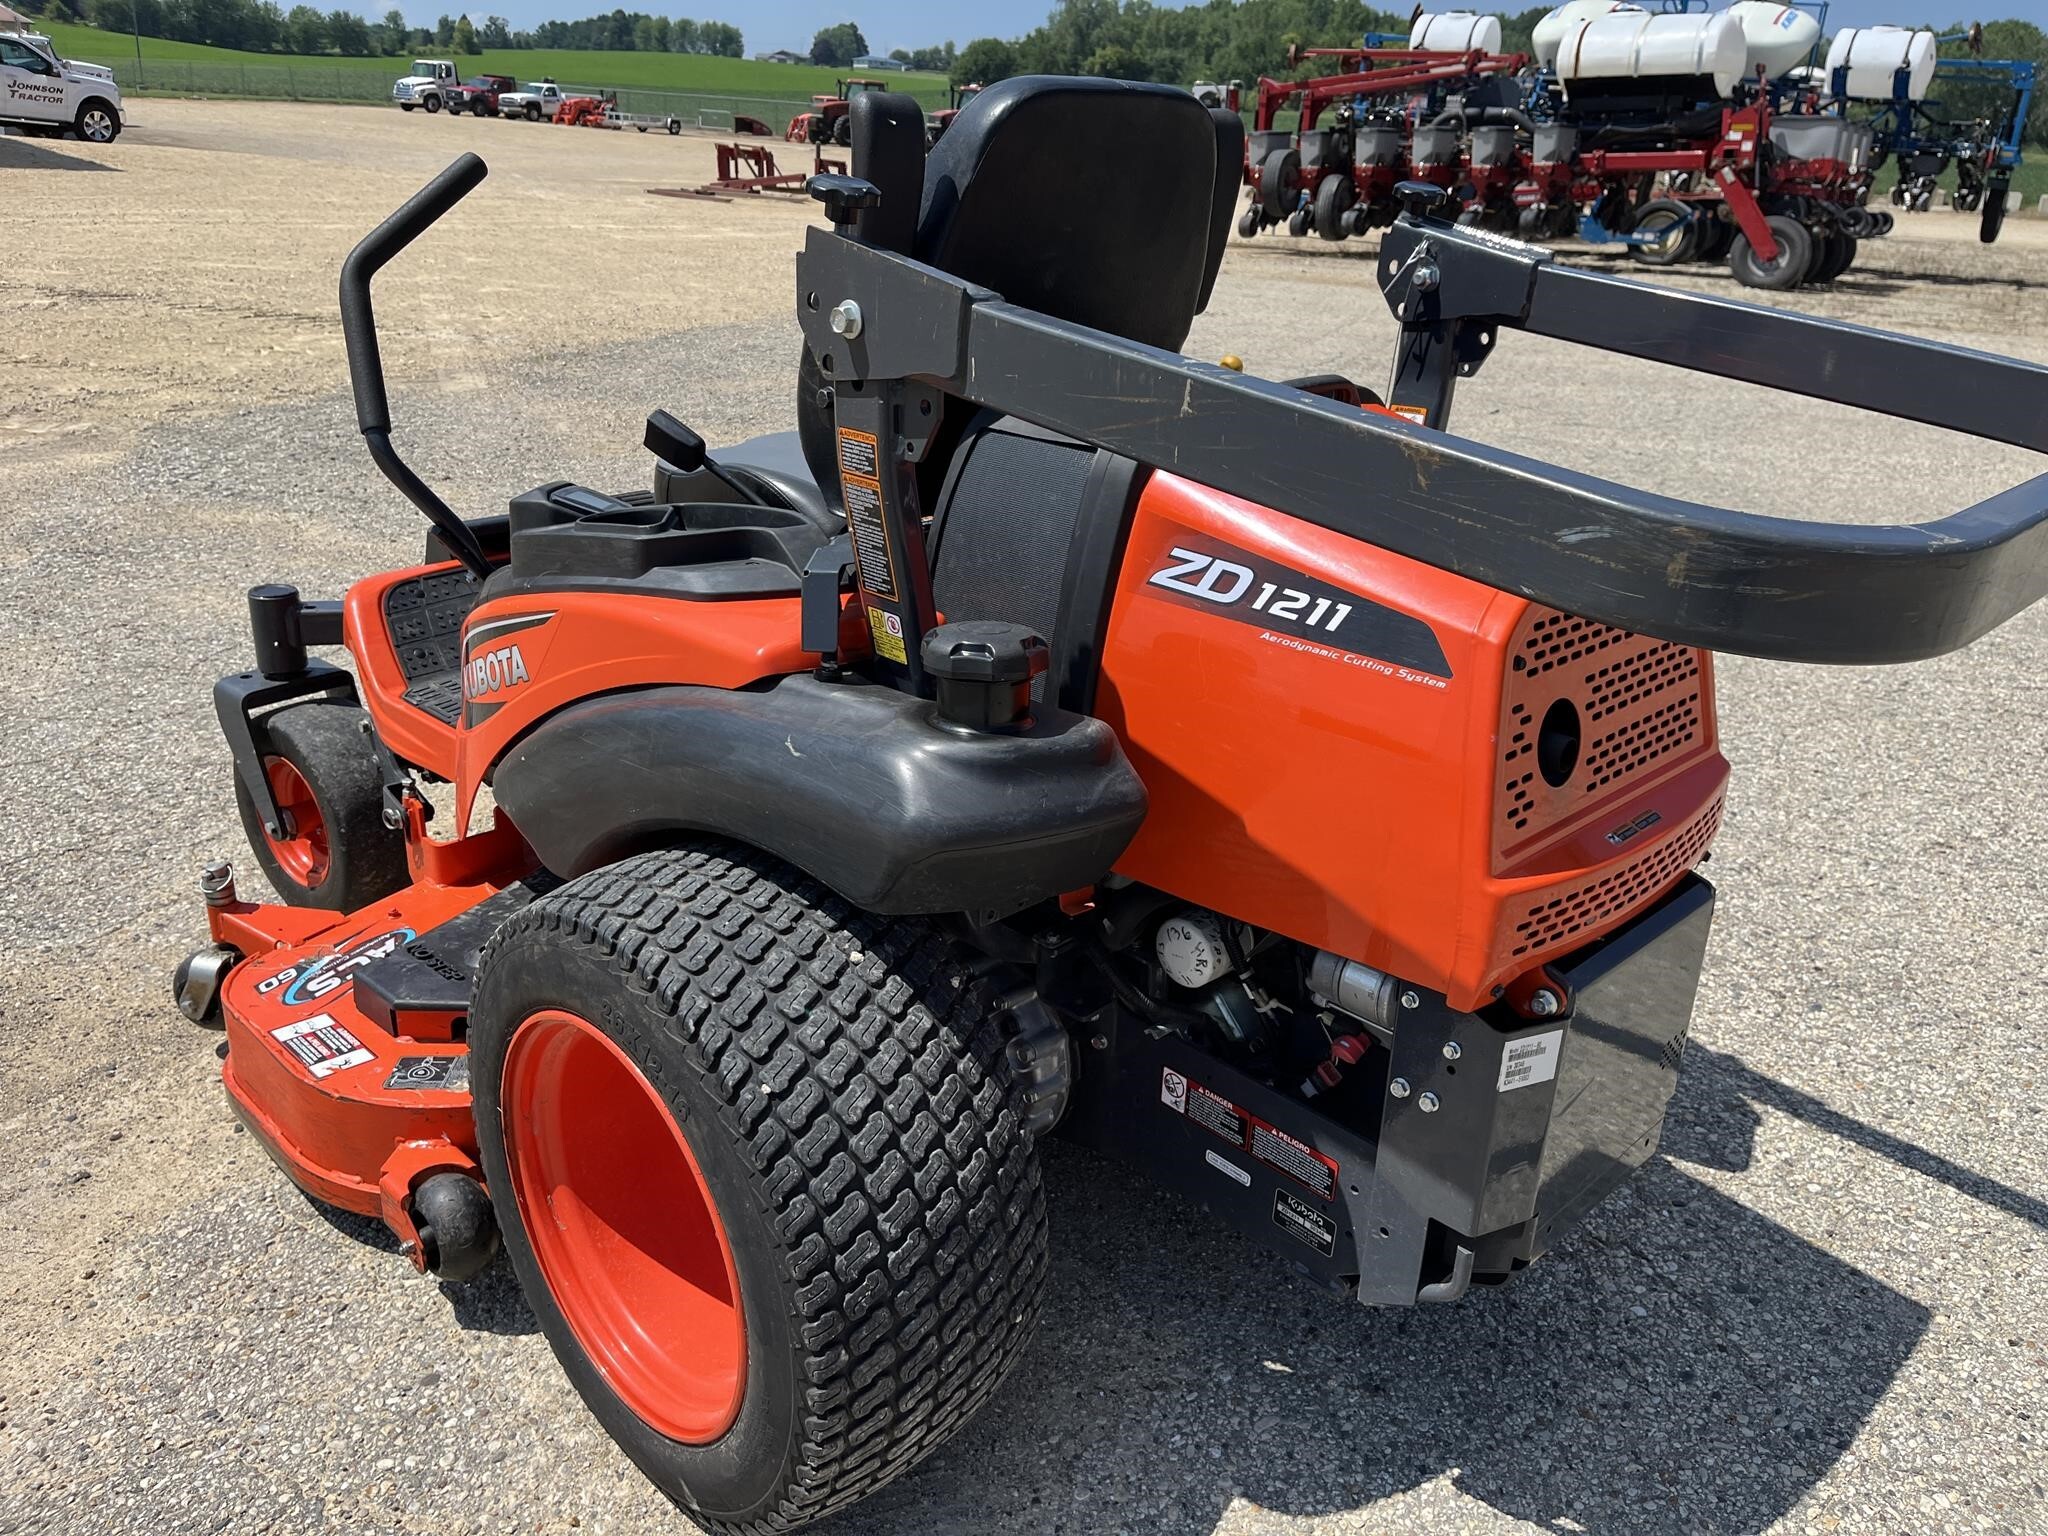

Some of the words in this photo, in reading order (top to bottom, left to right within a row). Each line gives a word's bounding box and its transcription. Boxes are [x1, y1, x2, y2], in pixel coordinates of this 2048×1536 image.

[1149, 546, 1255, 605] ZD
[1252, 582, 1353, 632] 1211
[1260, 631, 1340, 660] Aerodynamic
[1344, 654, 1394, 676] Cutting
[1396, 668, 1447, 689] System
[257, 967, 298, 993] 60
[1205, 1090, 1233, 1110] DANGER
[1279, 1132, 1310, 1154] PELIGRO
[1287, 1196, 1324, 1226] Kubota
